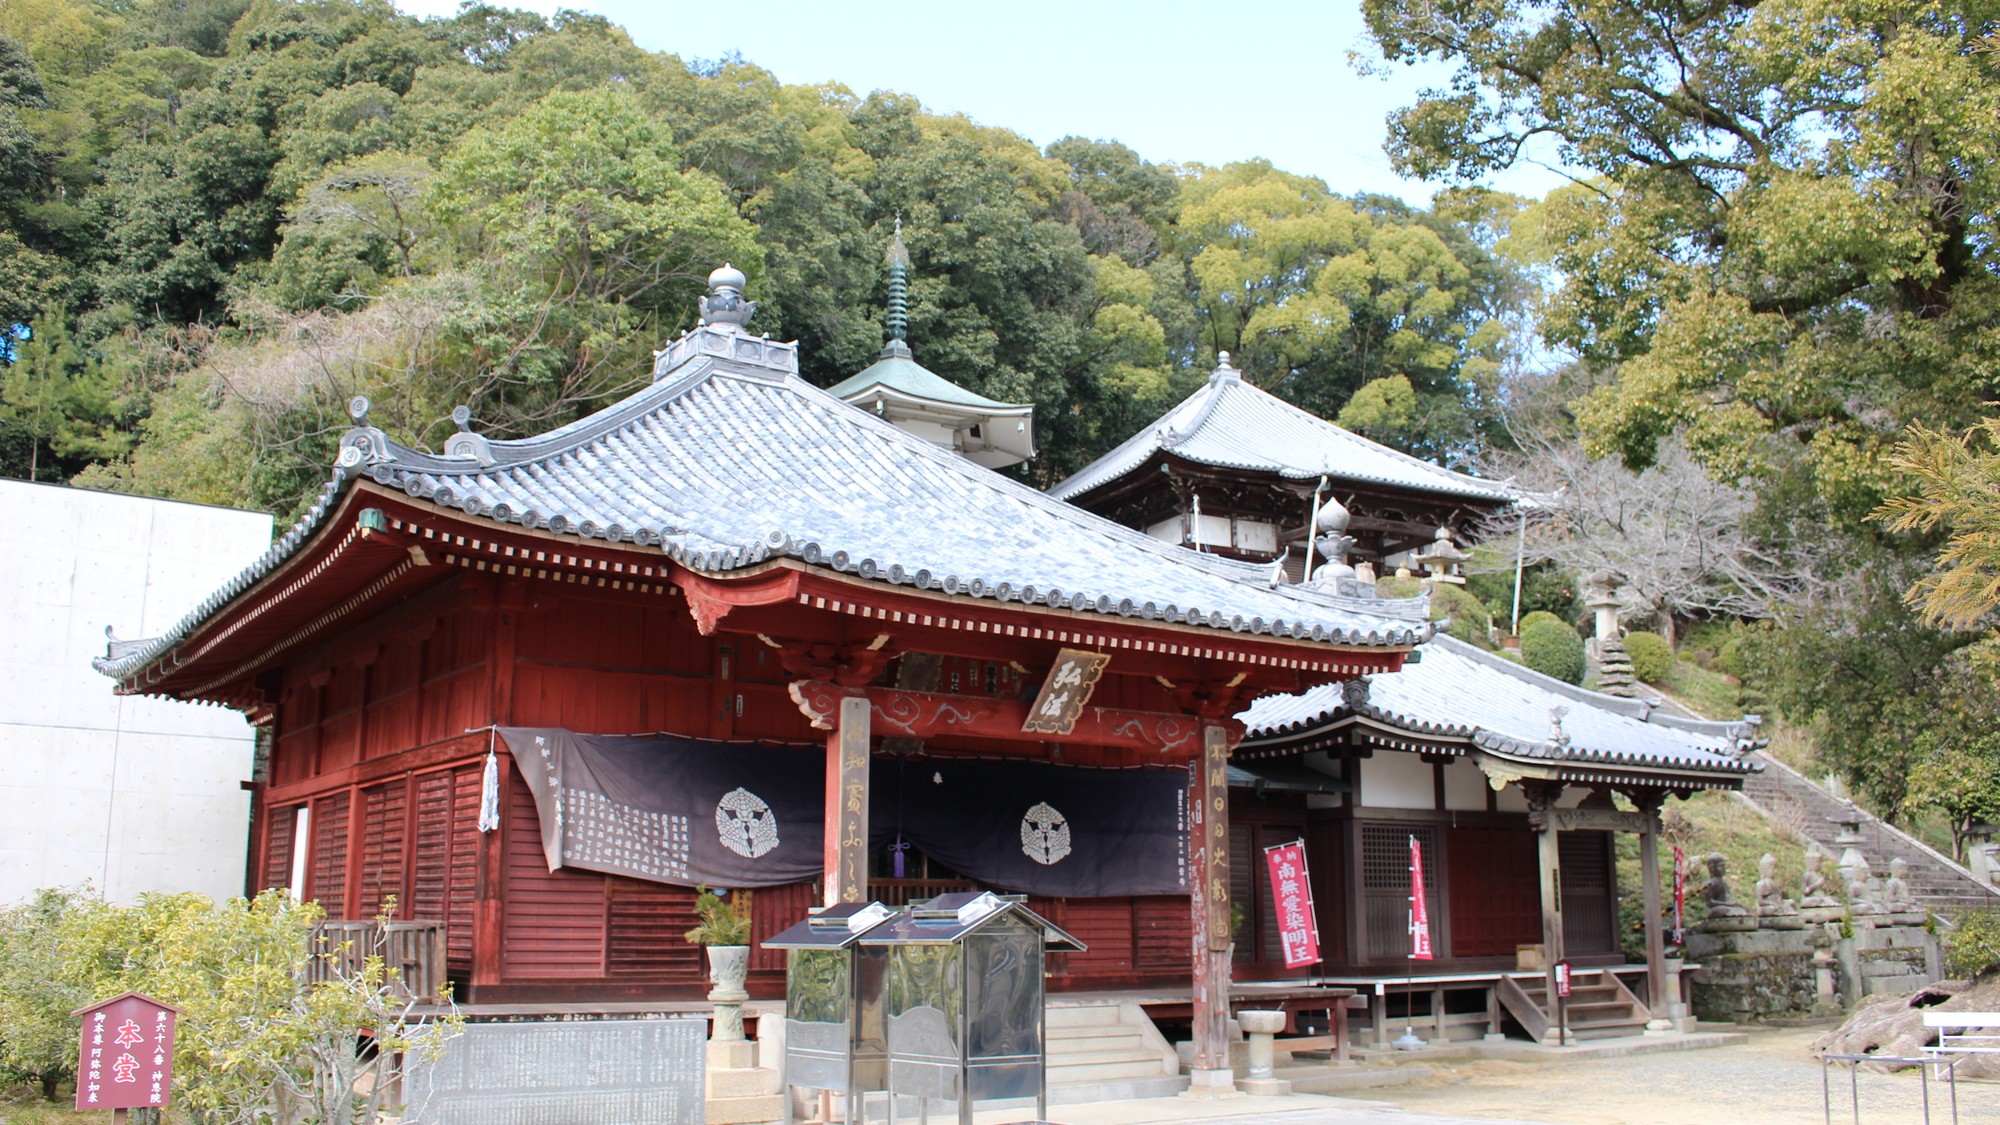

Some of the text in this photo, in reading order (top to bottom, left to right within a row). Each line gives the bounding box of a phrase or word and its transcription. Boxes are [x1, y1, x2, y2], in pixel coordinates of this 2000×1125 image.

[1277, 862, 1312, 963] 南無愛染明王
[113, 1018, 145, 1083] 本堂
